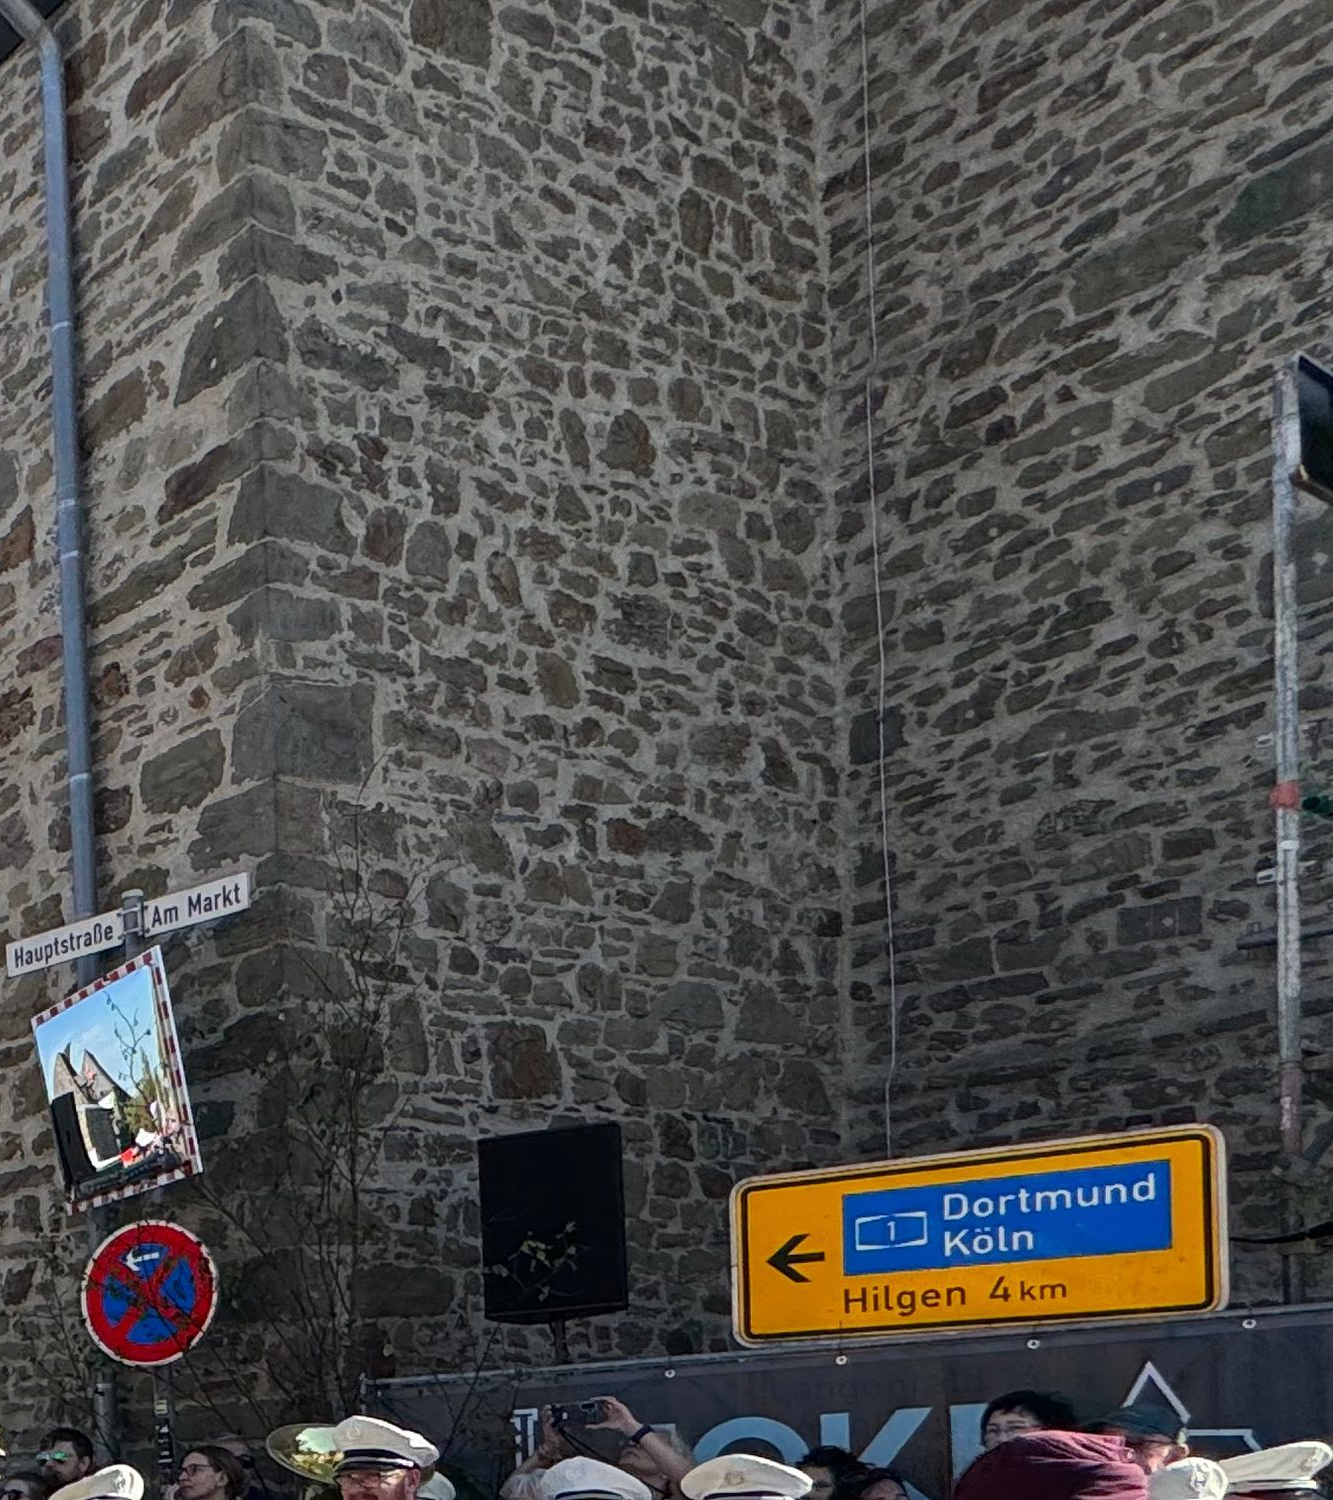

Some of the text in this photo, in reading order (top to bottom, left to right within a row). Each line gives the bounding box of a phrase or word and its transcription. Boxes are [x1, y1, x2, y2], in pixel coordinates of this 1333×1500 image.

[151, 883, 241, 928] Am Markt
[14, 923, 114, 969] Hauptstraße
[943, 1172, 1156, 1222] Dortmund
[886, 1220, 896, 1242] 1
[943, 1226, 1034, 1257] Köln
[843, 1276, 1068, 1316] Hilgen 4 km
